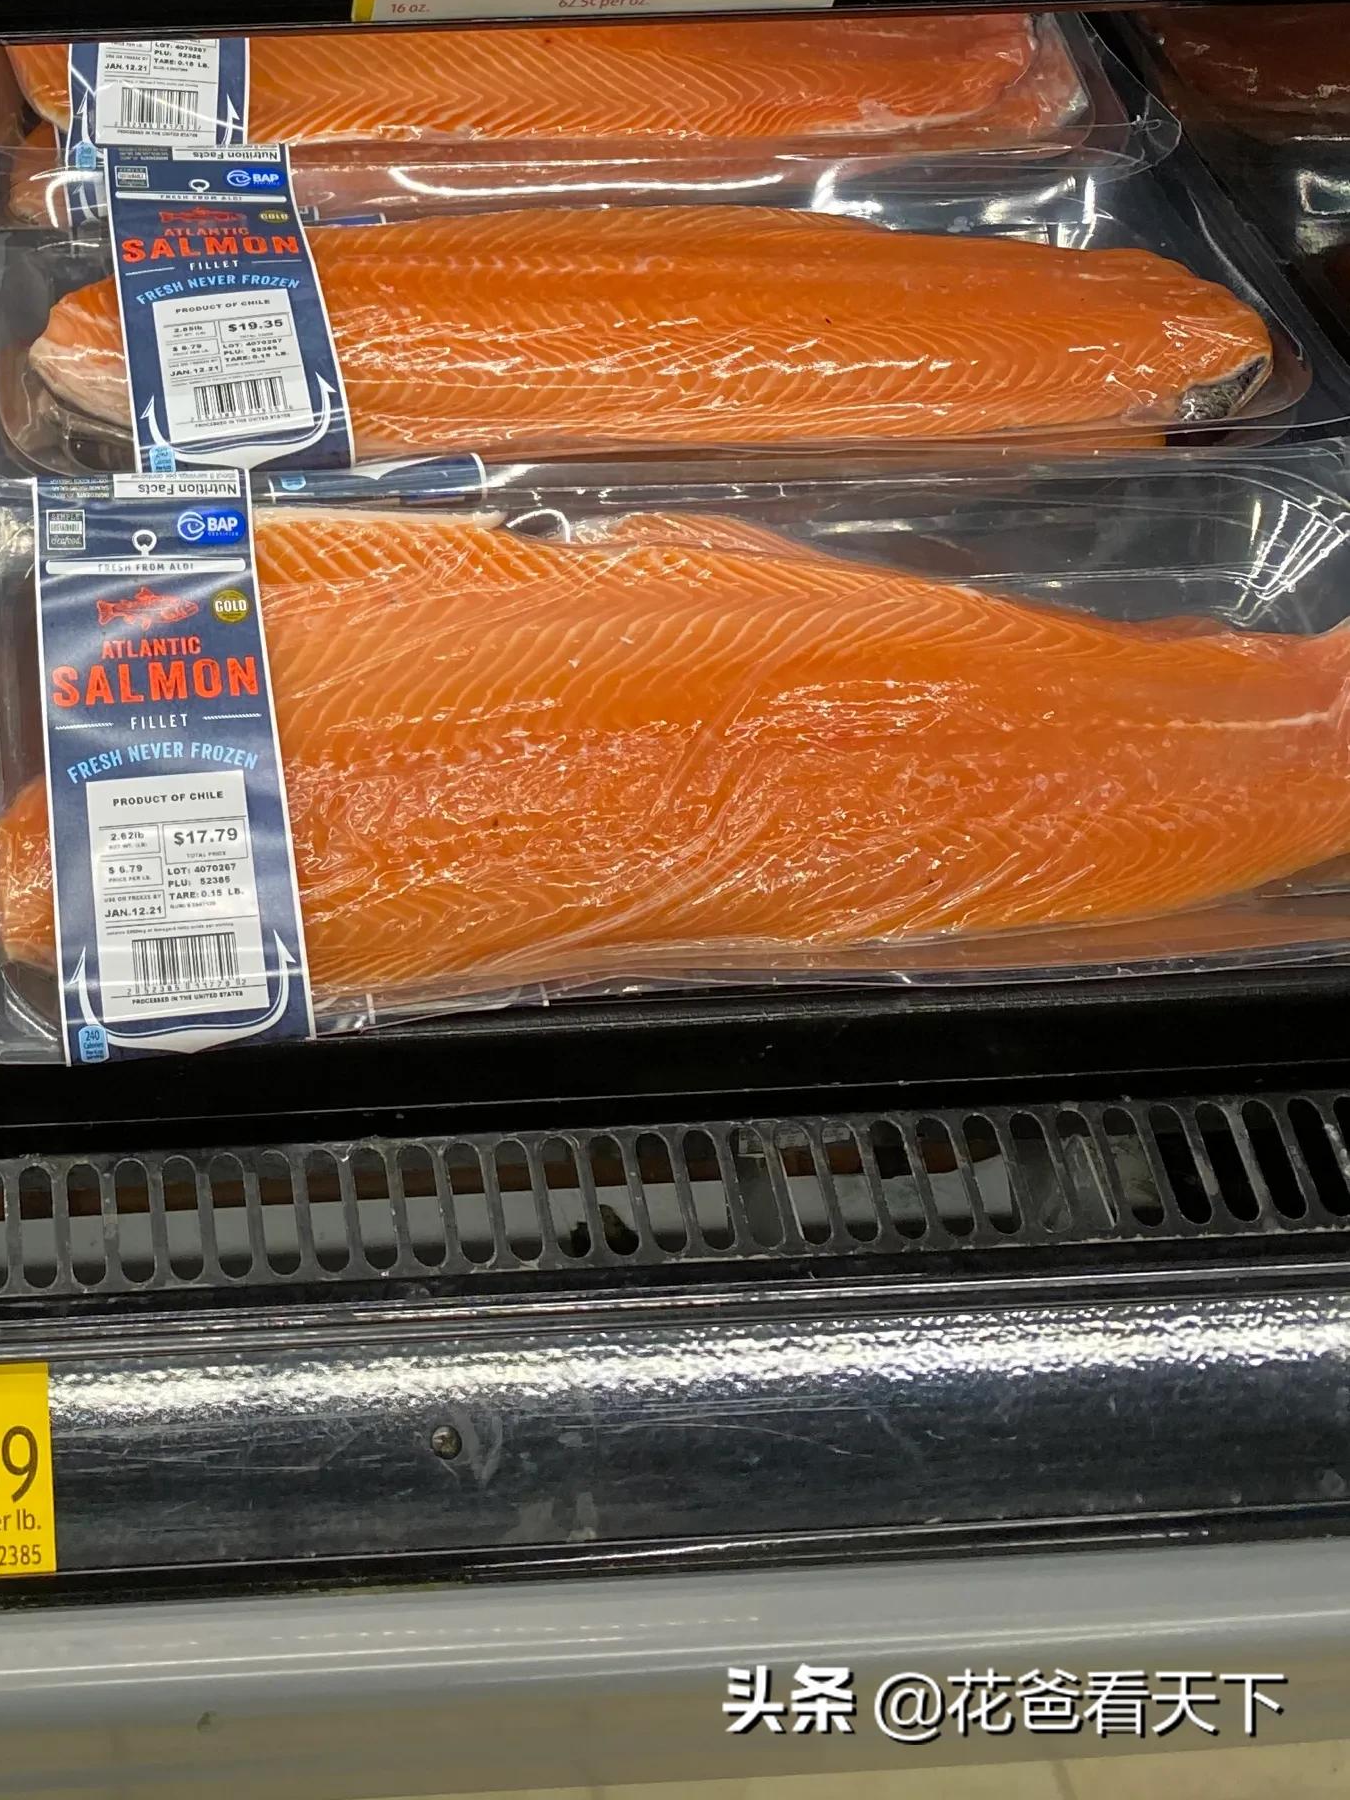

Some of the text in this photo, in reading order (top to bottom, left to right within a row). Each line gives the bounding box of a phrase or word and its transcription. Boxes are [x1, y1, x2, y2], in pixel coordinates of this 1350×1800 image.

[391, 3, 406, 14] 16
[252, 173, 279, 183] BAP
[121, 236, 300, 263] SALMON
[190, 259, 240, 271] FILLET
[135, 274, 301, 305] FRESH NEVER FROZEN
[228, 319, 283, 334] $19.35
[138, 483, 237, 494] Nutrition Facts
[207, 517, 238, 532] BAP
[214, 600, 247, 613] GOLD
[101, 636, 201, 659] ATLANTIC
[52, 656, 258, 708] SALMON
[130, 714, 188, 730] FILLET
[66, 742, 258, 784] FRESH NEVER FROZEN
[112, 790, 224, 807] PRODUCT OF CHILE
[174, 828, 238, 846] $17.79
[168, 867, 191, 875] LOT:
[168, 879, 191, 887] PLU:
[169, 892, 199, 900] TARE:
[105, 906, 162, 918] JAN.12.21
[17, 1509, 42, 1533] lb.
